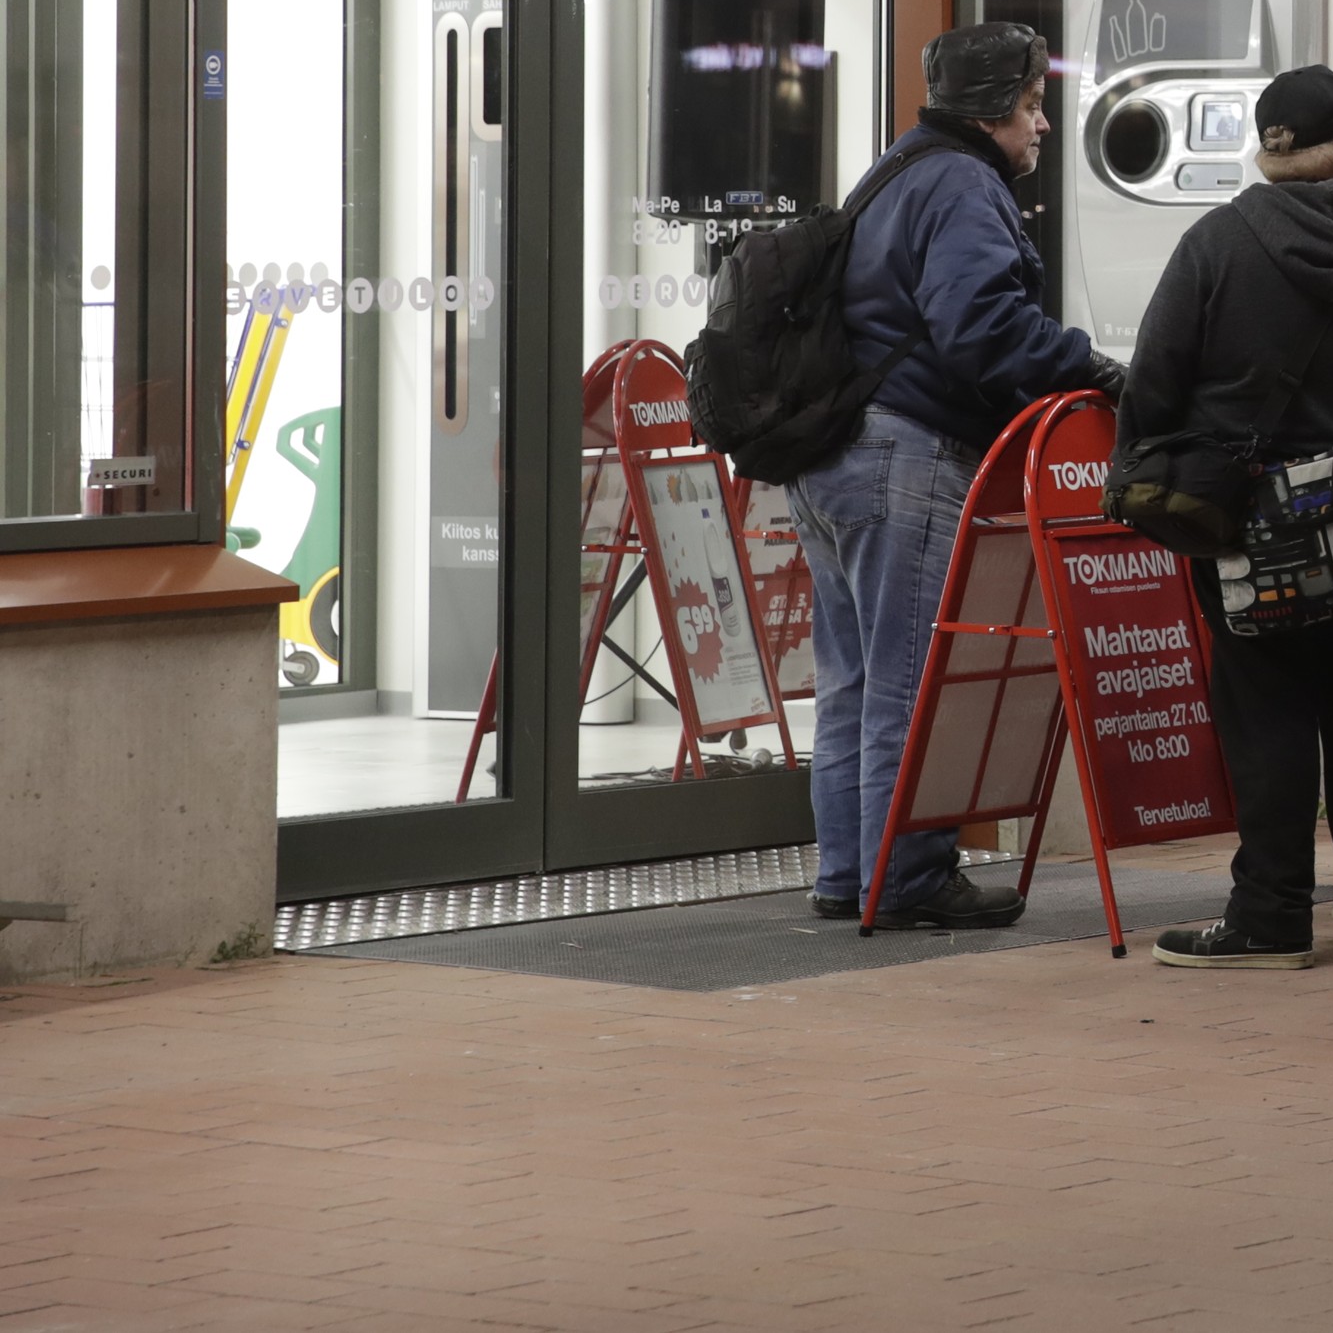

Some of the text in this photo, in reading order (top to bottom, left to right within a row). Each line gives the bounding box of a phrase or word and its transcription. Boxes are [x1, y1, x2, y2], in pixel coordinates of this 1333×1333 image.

[632, 195, 797, 213] Ma-Pe La Su
[632, 219, 682, 245] 8-20
[441, 522, 481, 540] Kiitos
[1063, 549, 1177, 586] TOKMANNI
[1083, 620, 1191, 658] Mahtavat
[1096, 656, 1195, 698] avajaiset
[1094, 700, 1211, 741] perjantaina 27.10.
[1127, 734, 1190, 763] klo 8:00
[1134, 797, 1212, 827] Tervetuloa!
